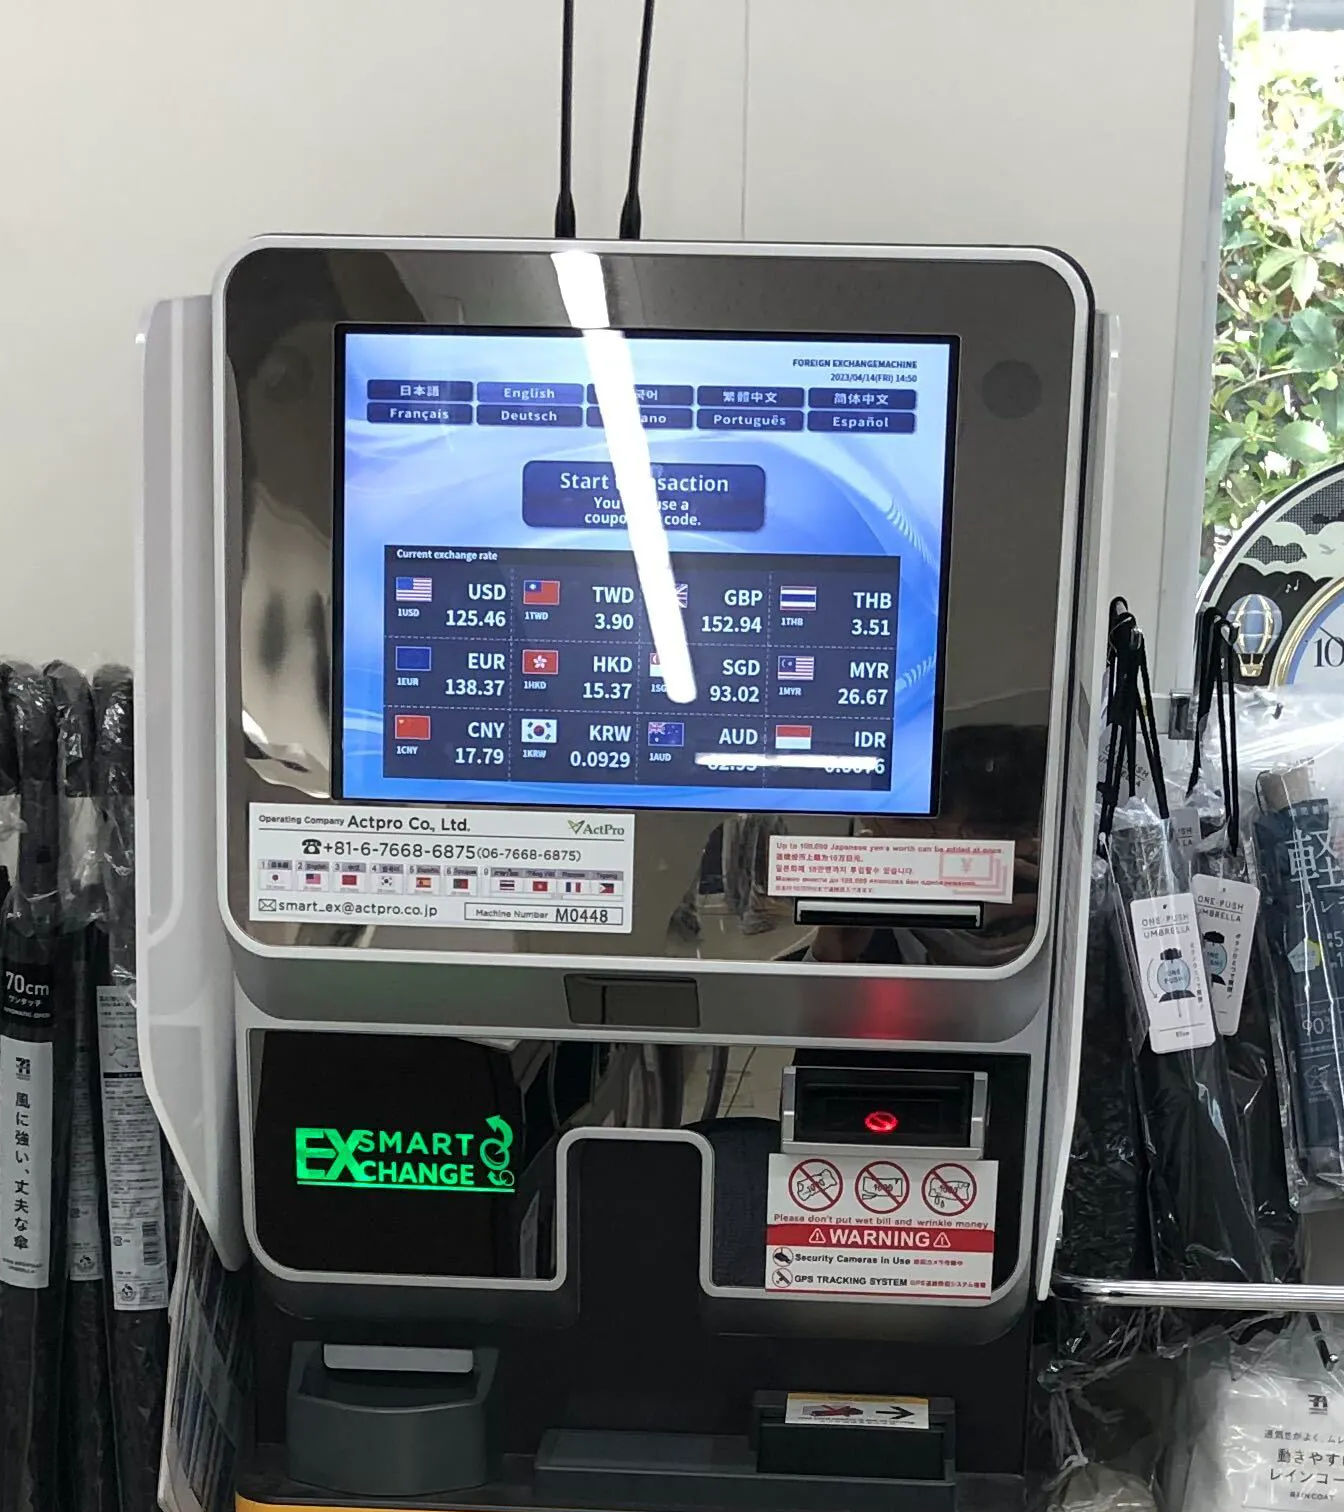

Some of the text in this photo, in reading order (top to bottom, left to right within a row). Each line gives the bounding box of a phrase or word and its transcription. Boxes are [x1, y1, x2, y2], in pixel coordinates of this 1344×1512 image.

[400, 384, 440, 397] 日本語
[503, 387, 555, 400] English
[390, 407, 449, 420] Français
[501, 410, 558, 422] Deutsch
[713, 414, 786, 428] Português
[833, 416, 889, 430] Español
[560, 473, 609, 490] Start
[593, 496, 621, 510] You
[664, 513, 701, 526] code.
[396, 549, 498, 562] Current exchange rate
[468, 583, 506, 600] USD
[592, 586, 634, 604] TWD
[724, 589, 763, 606] GBP
[853, 592, 892, 609] THB
[446, 610, 506, 627] 125.46
[594, 613, 634, 630] 3.90
[701, 615, 762, 633] 152.94
[851, 619, 891, 636] 3.51
[468, 652, 505, 670] EUR
[593, 656, 633, 673] HKD
[722, 659, 760, 675] SGD
[850, 661, 889, 679] MYR
[445, 678, 505, 696] 138.37
[583, 682, 632, 699] 15.37
[710, 685, 760, 702] 93.02
[838, 688, 888, 705] 26.67
[467, 721, 505, 739] CNY
[589, 724, 632, 742] KRW
[719, 728, 758, 745] AUD
[855, 731, 886, 748] IDR
[455, 747, 504, 764] 17.79
[570, 750, 631, 768] 0.0929
[259, 814, 302, 826] Operating
[304, 815, 345, 828] Company
[347, 815, 404, 833] Actpro
[441, 817, 471, 832] Ltd.
[582, 823, 625, 837] ActPro
[278, 900, 438, 917] smart_ex@actpro.co.jp
[476, 907, 609, 924] Machine Number M0448
[5, 970, 50, 996] 70cm
[358, 1130, 474, 1156] SMART
[13, 1091, 31, 1250] 風に強い、丈夫な傘
[774, 1214, 805, 1223] Please
[808, 1215, 833, 1225] don't
[836, 1216, 852, 1226] put
[876, 1216, 892, 1226] bill
[894, 1217, 912, 1226] and
[917, 1219, 953, 1228] wrinkle
[956, 1220, 989, 1230] money
[829, 1229, 930, 1248] WARNING
[795, 1253, 911, 1265] Security Cameras Use
[794, 1275, 814, 1284] GPS
[816, 1275, 867, 1286] TRACKING
[869, 1277, 908, 1287] SYSTEM
